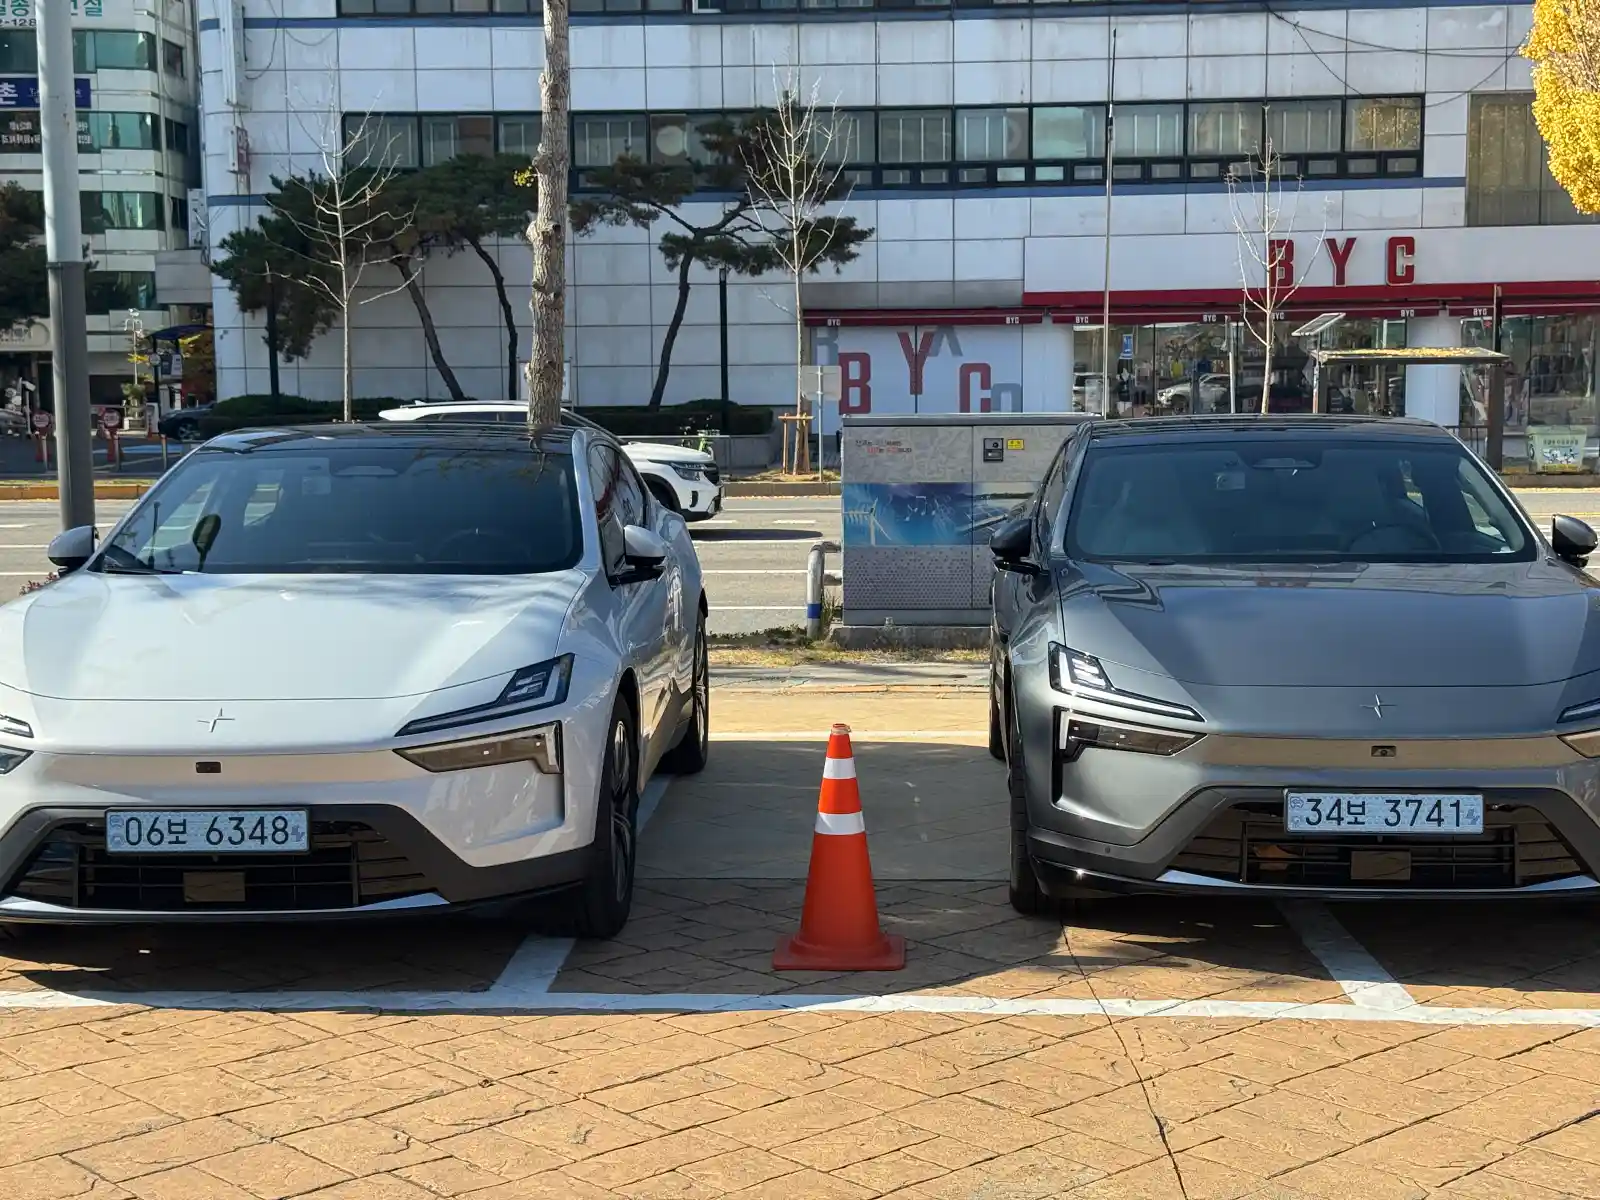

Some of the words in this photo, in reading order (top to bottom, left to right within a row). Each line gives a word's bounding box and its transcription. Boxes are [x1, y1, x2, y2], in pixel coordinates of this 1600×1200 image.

[1400, 309, 1415, 317] BYC
[1005, 316, 1019, 324] BYC
[1075, 316, 1089, 324] BYC
[1203, 314, 1216, 322] BYC
[827, 319, 841, 327] BYC
[1305, 798, 1366, 826] 34보
[1384, 799, 1461, 827] 3741
[125, 816, 187, 846] 06보
[205, 815, 289, 846] 6348
